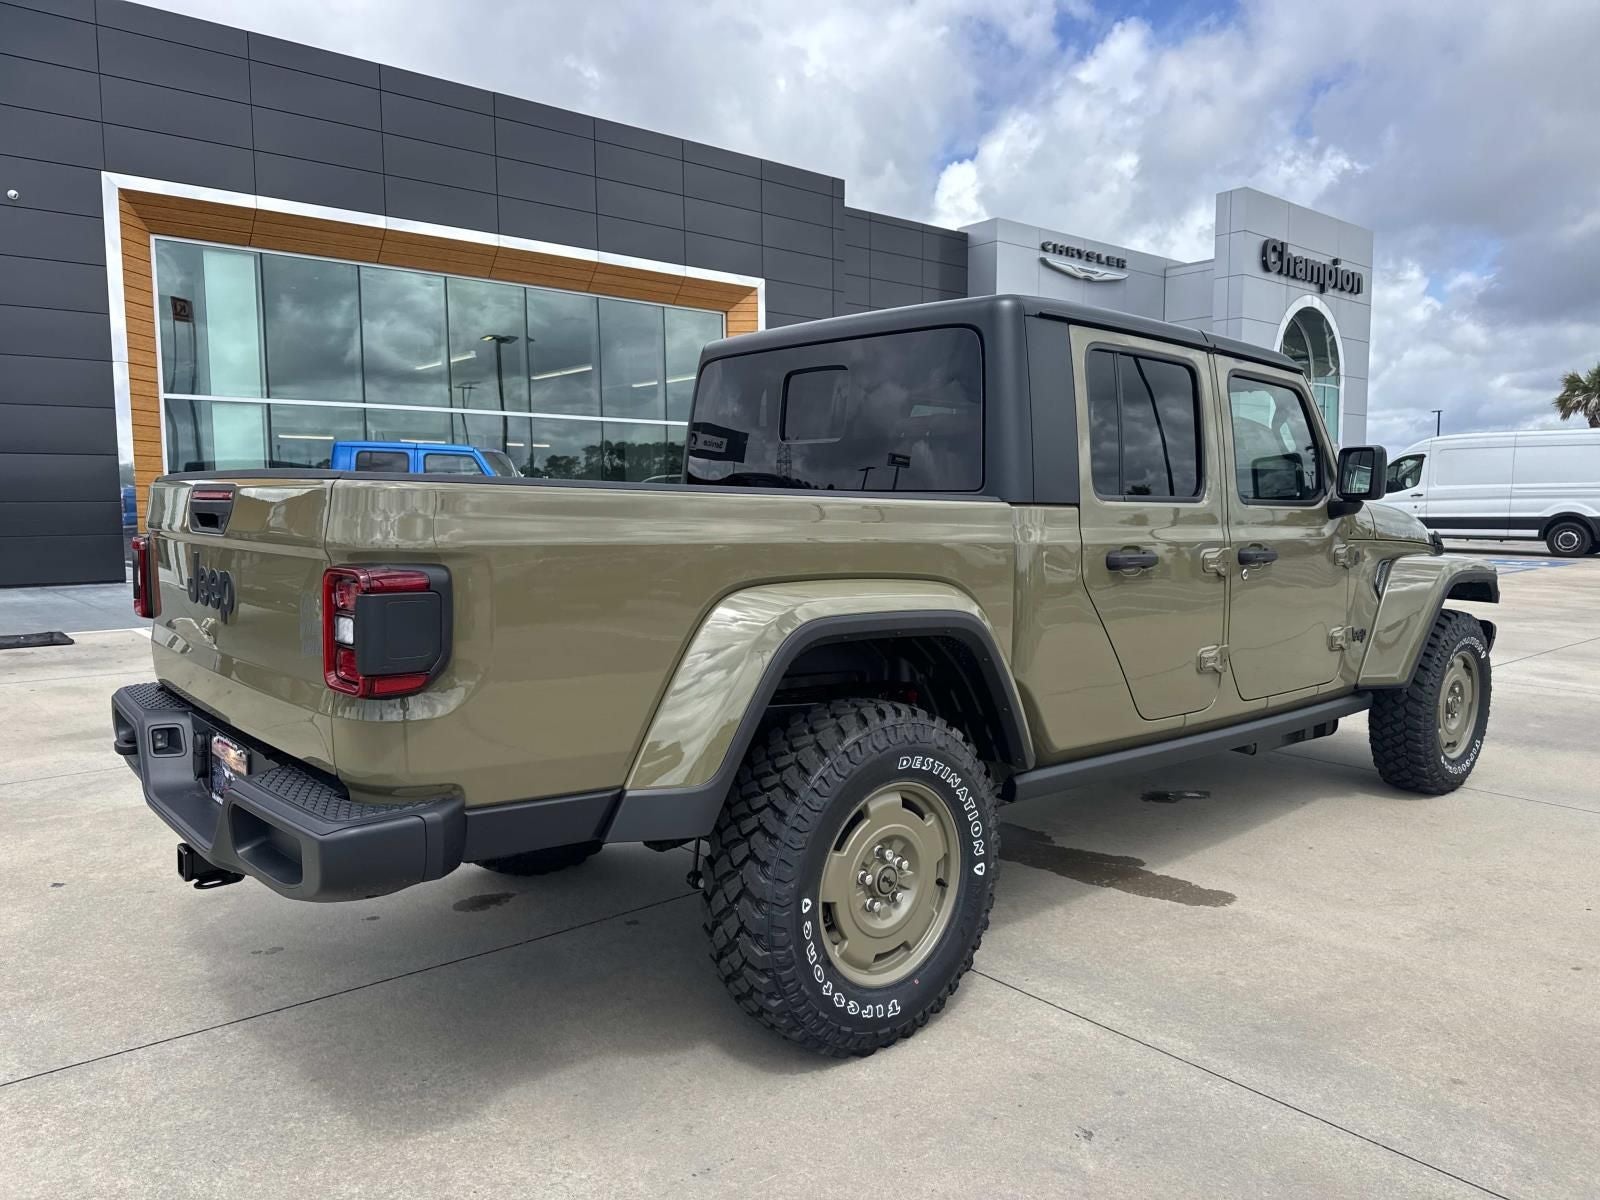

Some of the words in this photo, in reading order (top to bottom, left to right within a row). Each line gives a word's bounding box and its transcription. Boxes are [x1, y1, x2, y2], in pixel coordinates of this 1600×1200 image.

[1041, 240, 1127, 269] CHRYSLER
[1261, 238, 1363, 295] Champion
[187, 551, 236, 625] Jeep
[898, 755, 986, 857] DESTINATION
